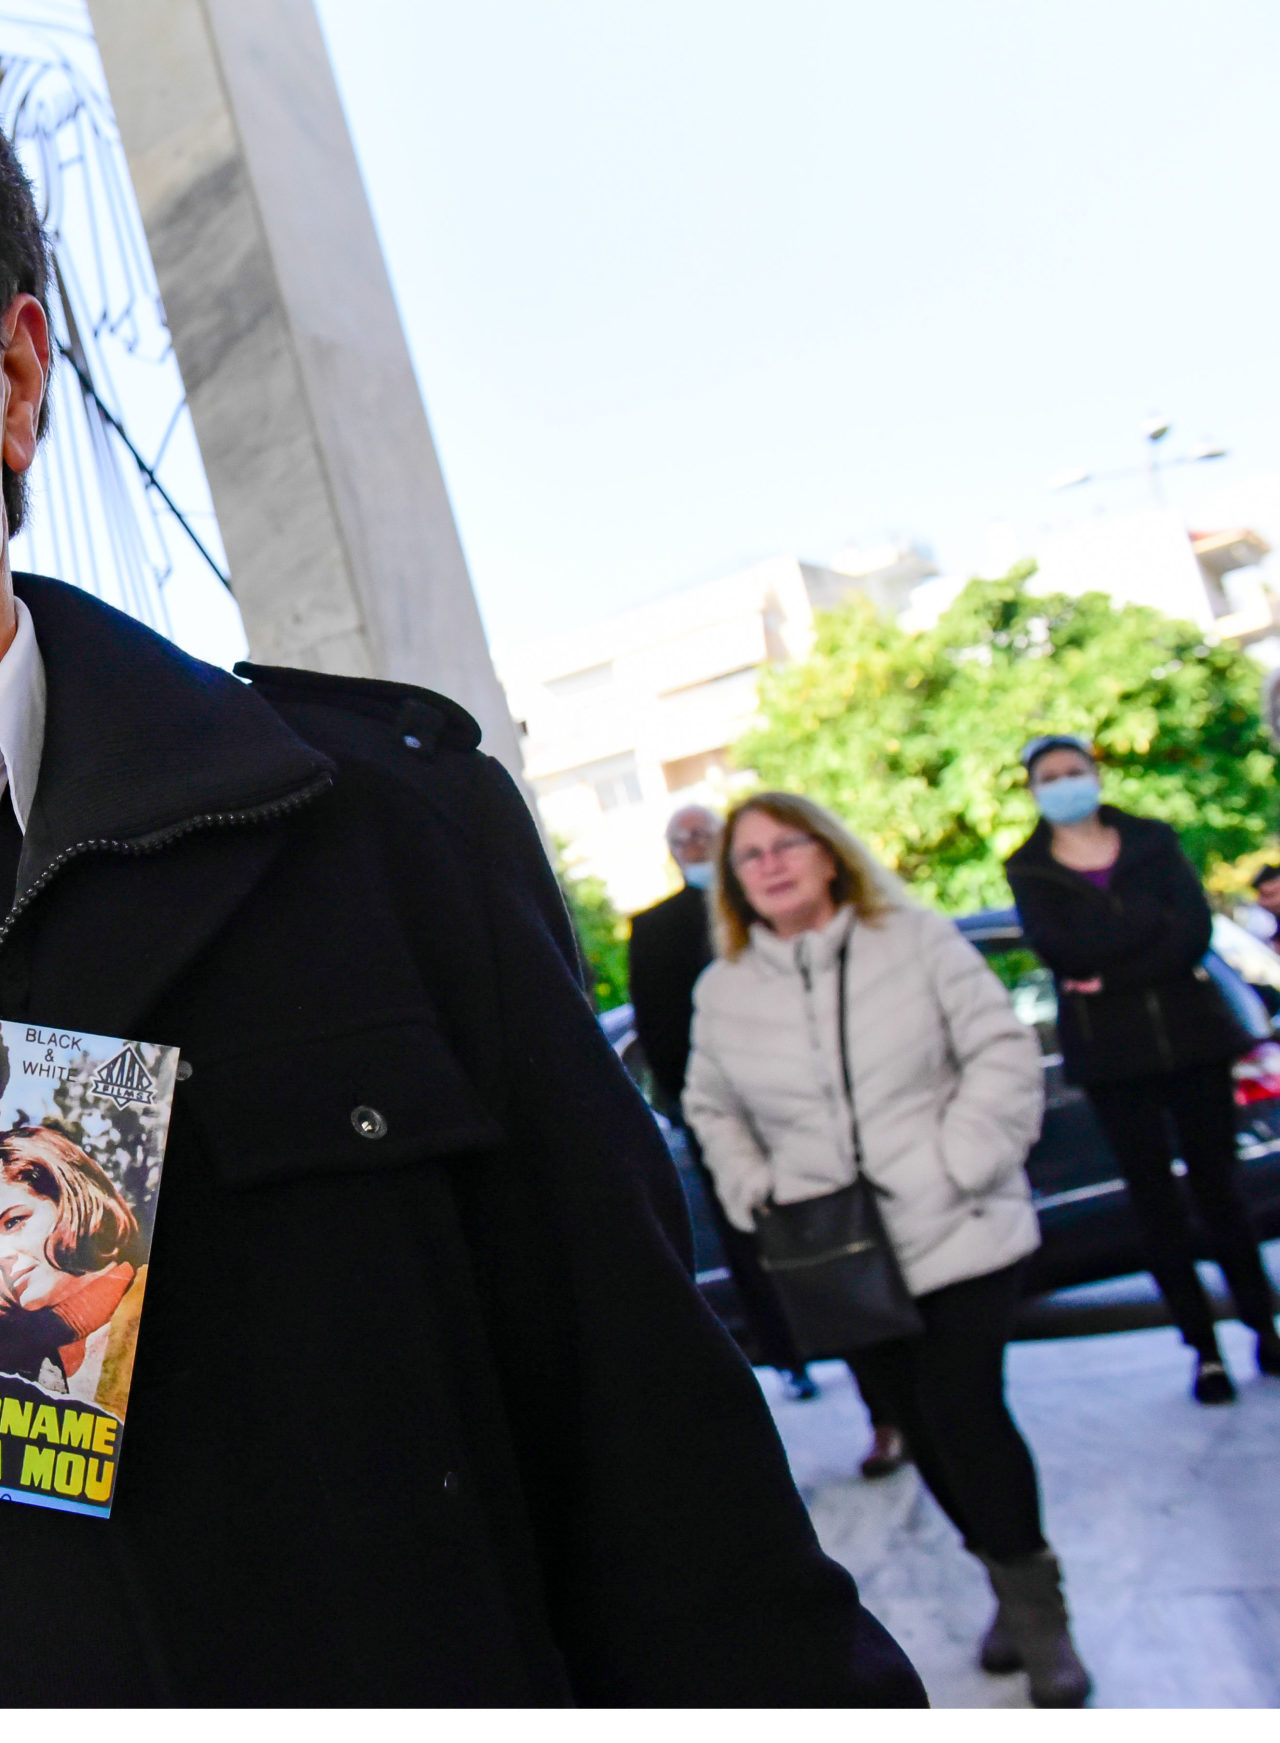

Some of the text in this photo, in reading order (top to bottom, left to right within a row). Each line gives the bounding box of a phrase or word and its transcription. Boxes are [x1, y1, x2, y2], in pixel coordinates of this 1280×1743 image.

[25, 1028, 82, 1051] BLACK
[44, 1048, 54, 1062] &
[23, 1060, 77, 1083] WHITE
[102, 1084, 144, 1100] FILMS
